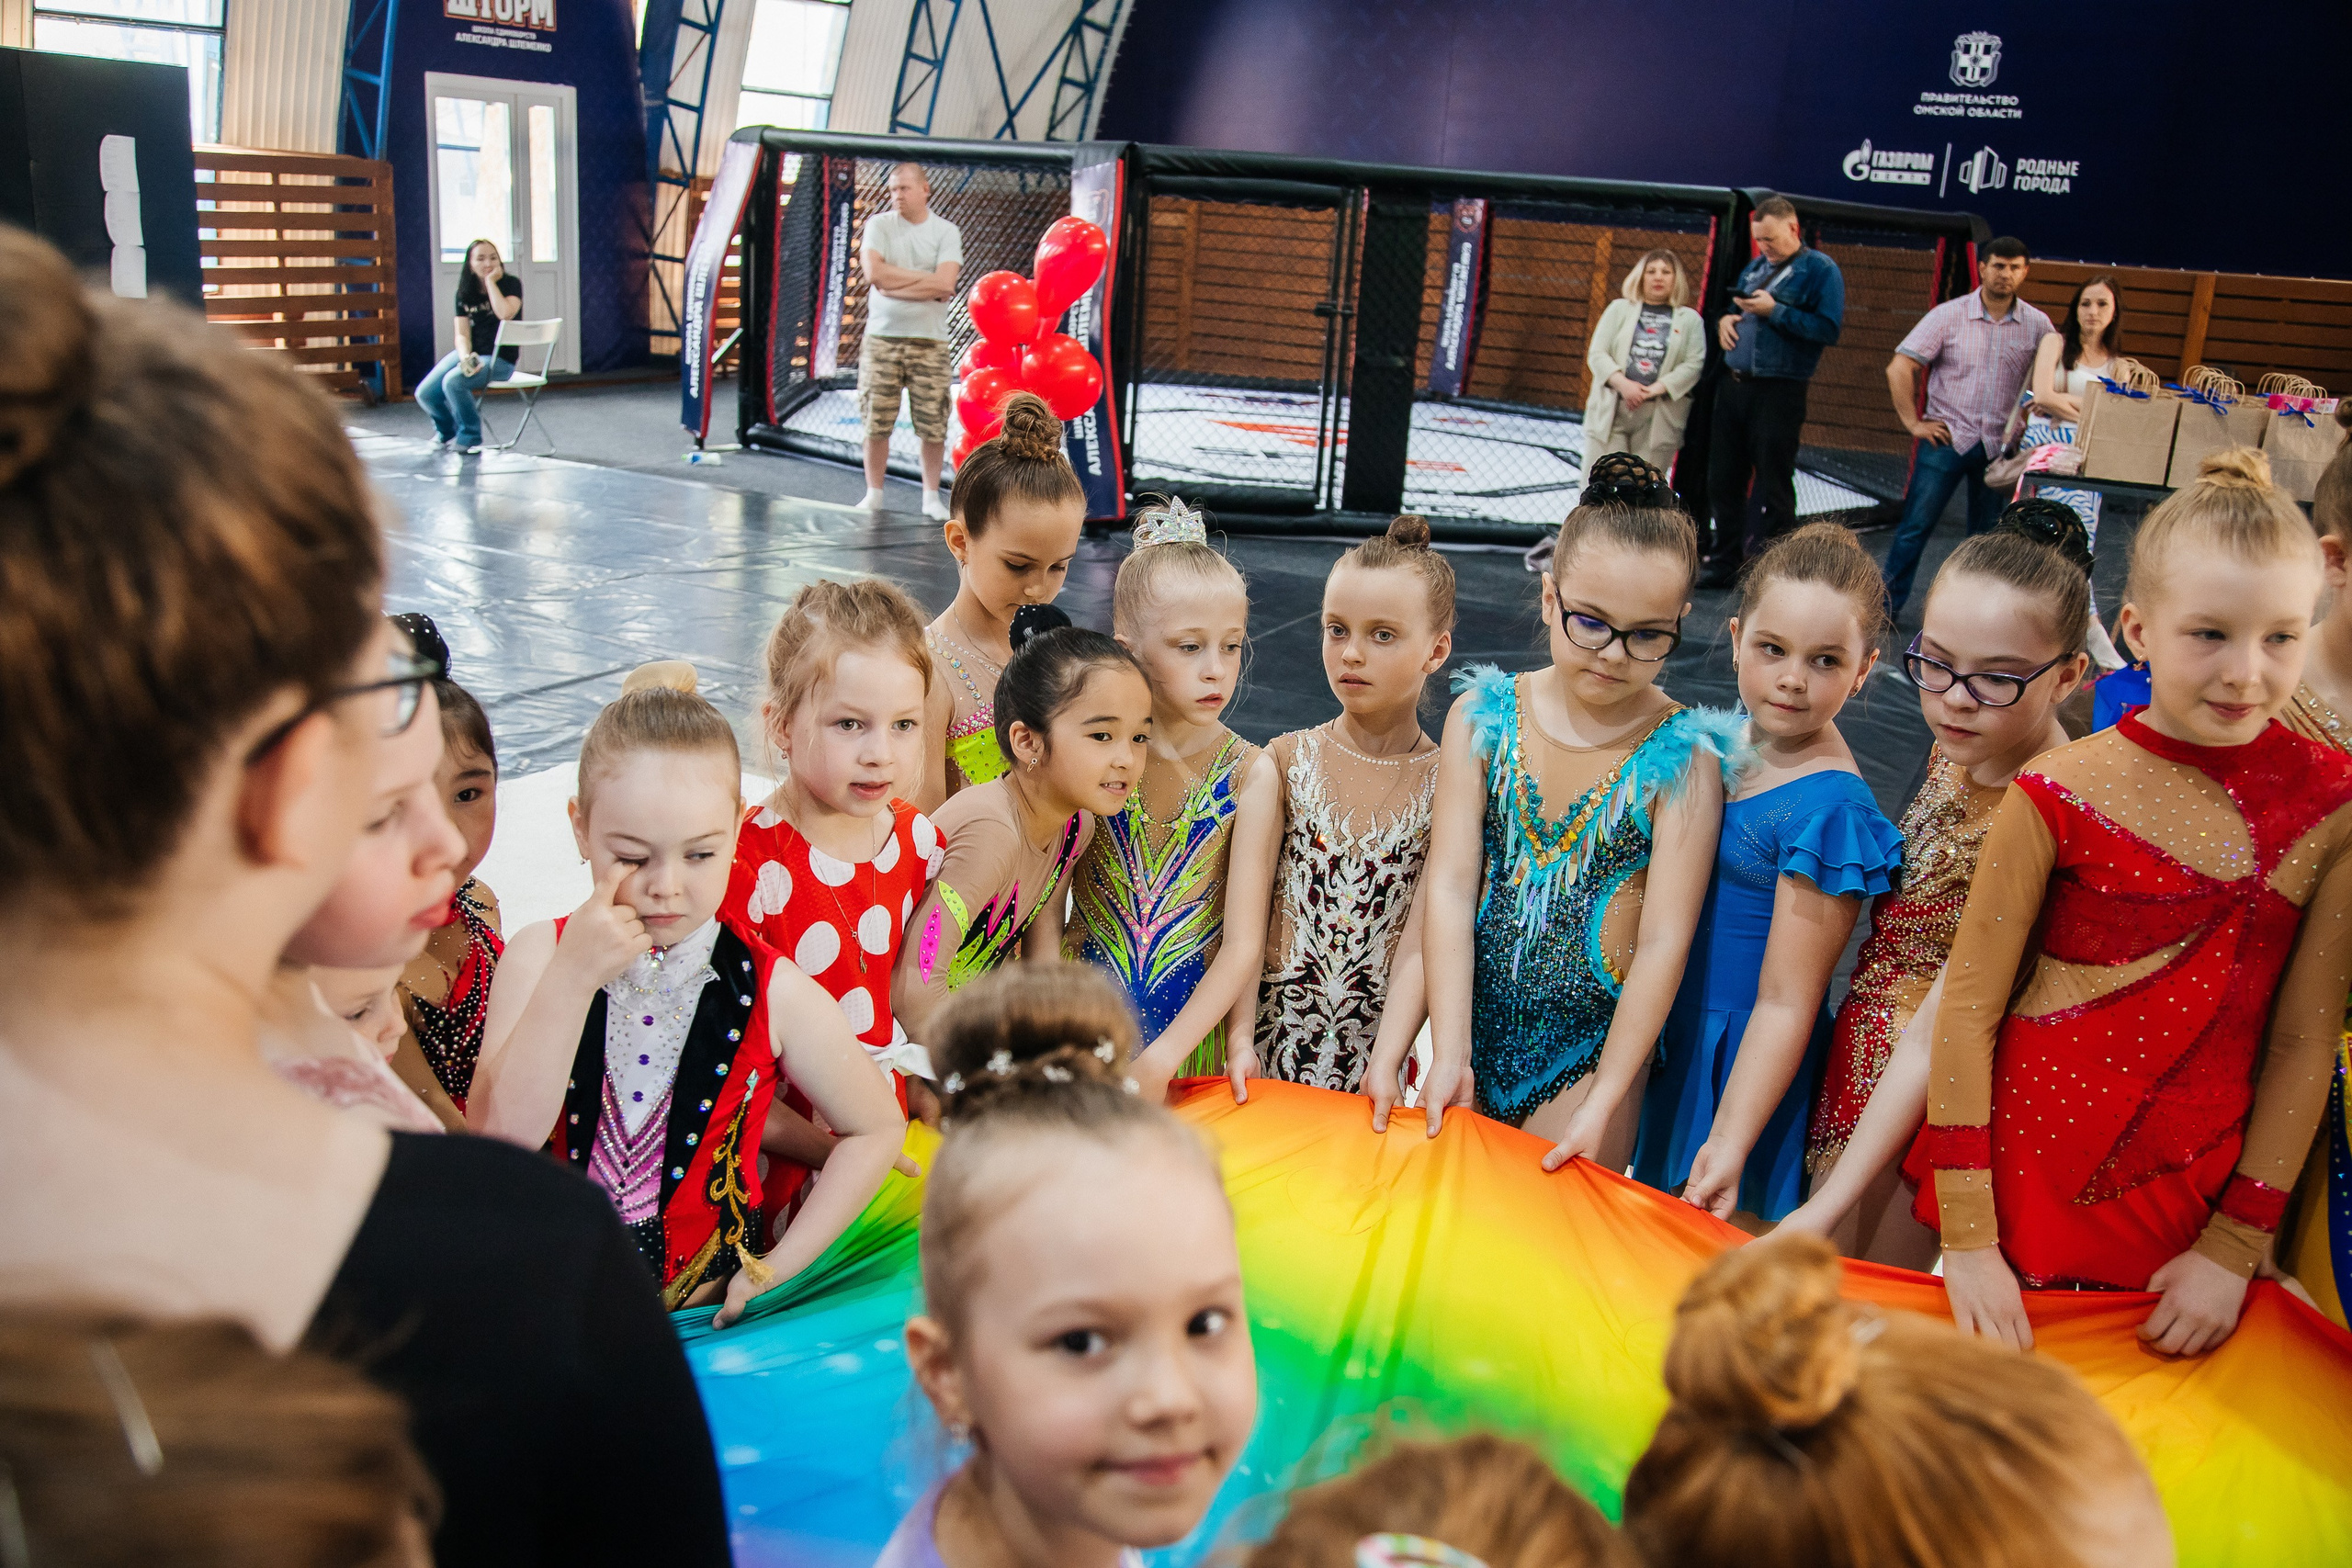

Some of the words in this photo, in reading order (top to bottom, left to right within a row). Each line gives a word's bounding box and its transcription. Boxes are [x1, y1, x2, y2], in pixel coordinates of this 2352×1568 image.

[1920, 92, 2019, 107] ПРАВИТЕЛЬСТВО
[1913, 104, 1965, 117] ОМСКОЙ
[1966, 107, 2023, 119] ОБЛАСТИ
[2016, 158, 2080, 177] РОДНЫЕ
[2013, 175, 2071, 195] ГОРОДА
